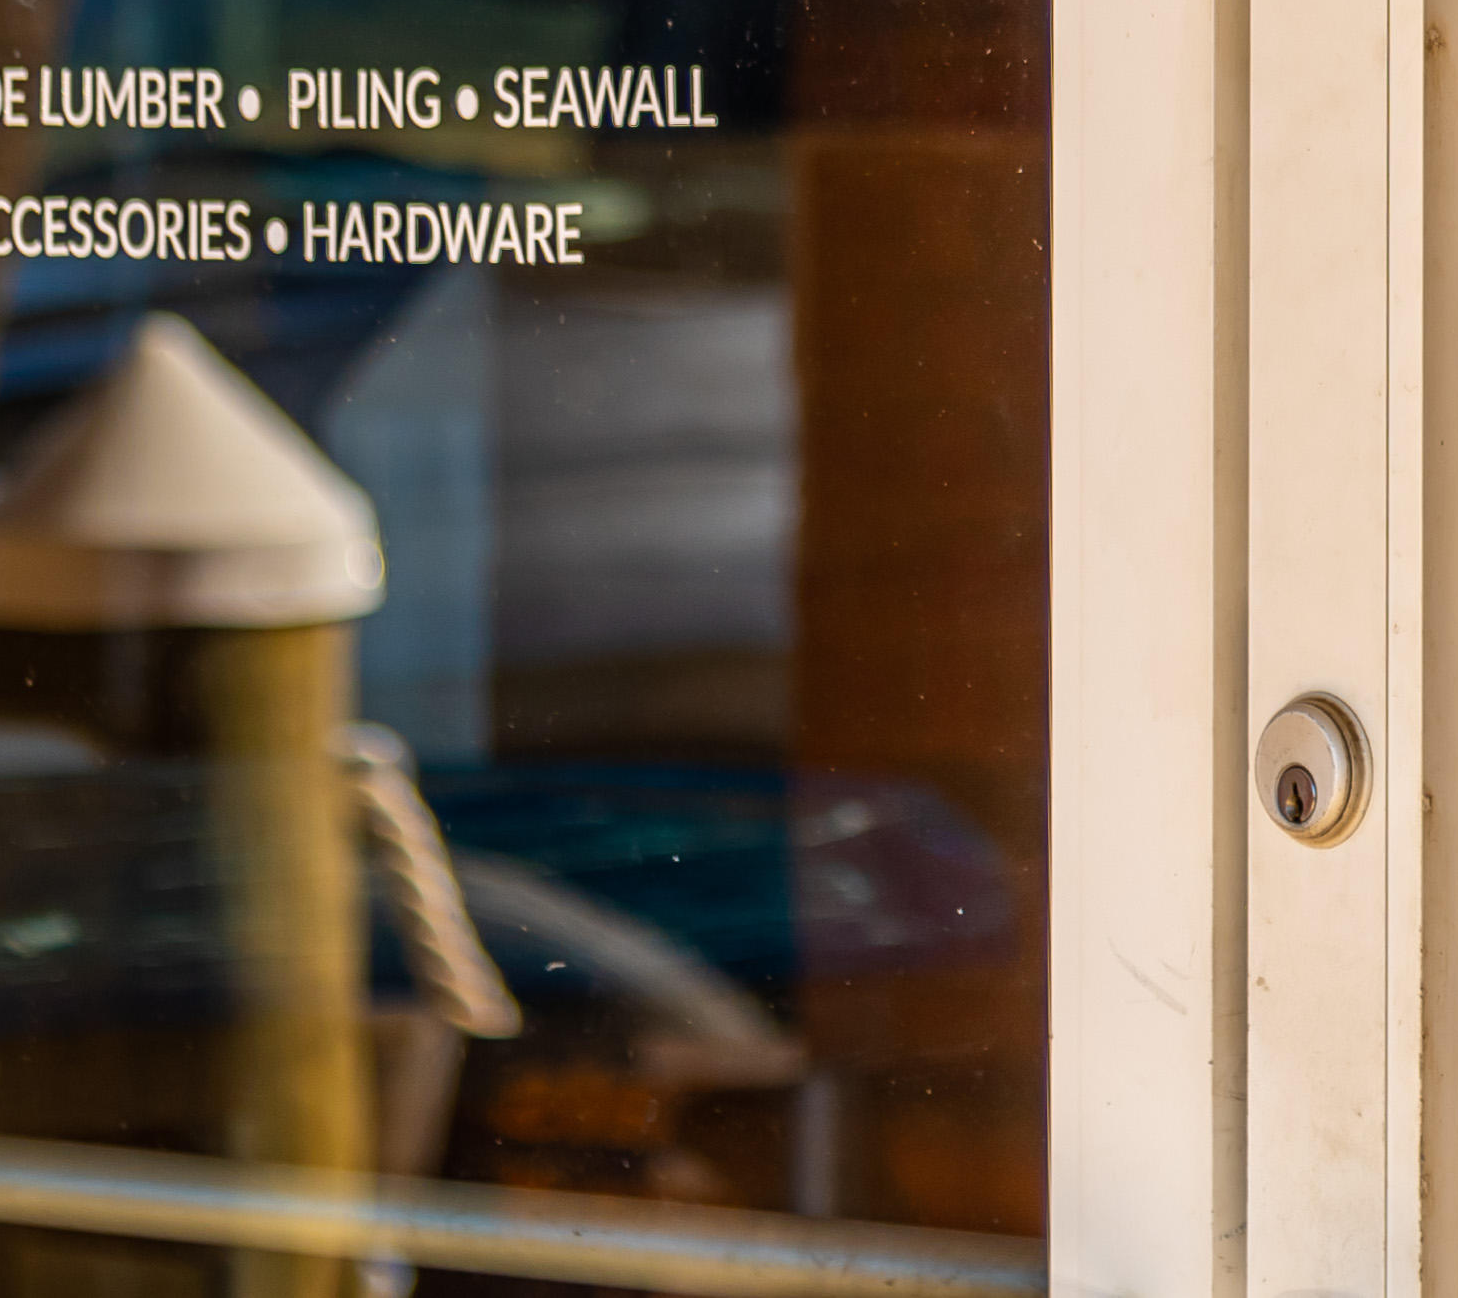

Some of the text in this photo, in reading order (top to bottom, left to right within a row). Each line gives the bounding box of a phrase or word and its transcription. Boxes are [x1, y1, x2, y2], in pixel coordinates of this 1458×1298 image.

[40, 66, 226, 129] LUMBER
[289, 68, 441, 130] PILING
[492, 66, 716, 130] SEAWALL
[303, 201, 585, 266] HARDWARE
